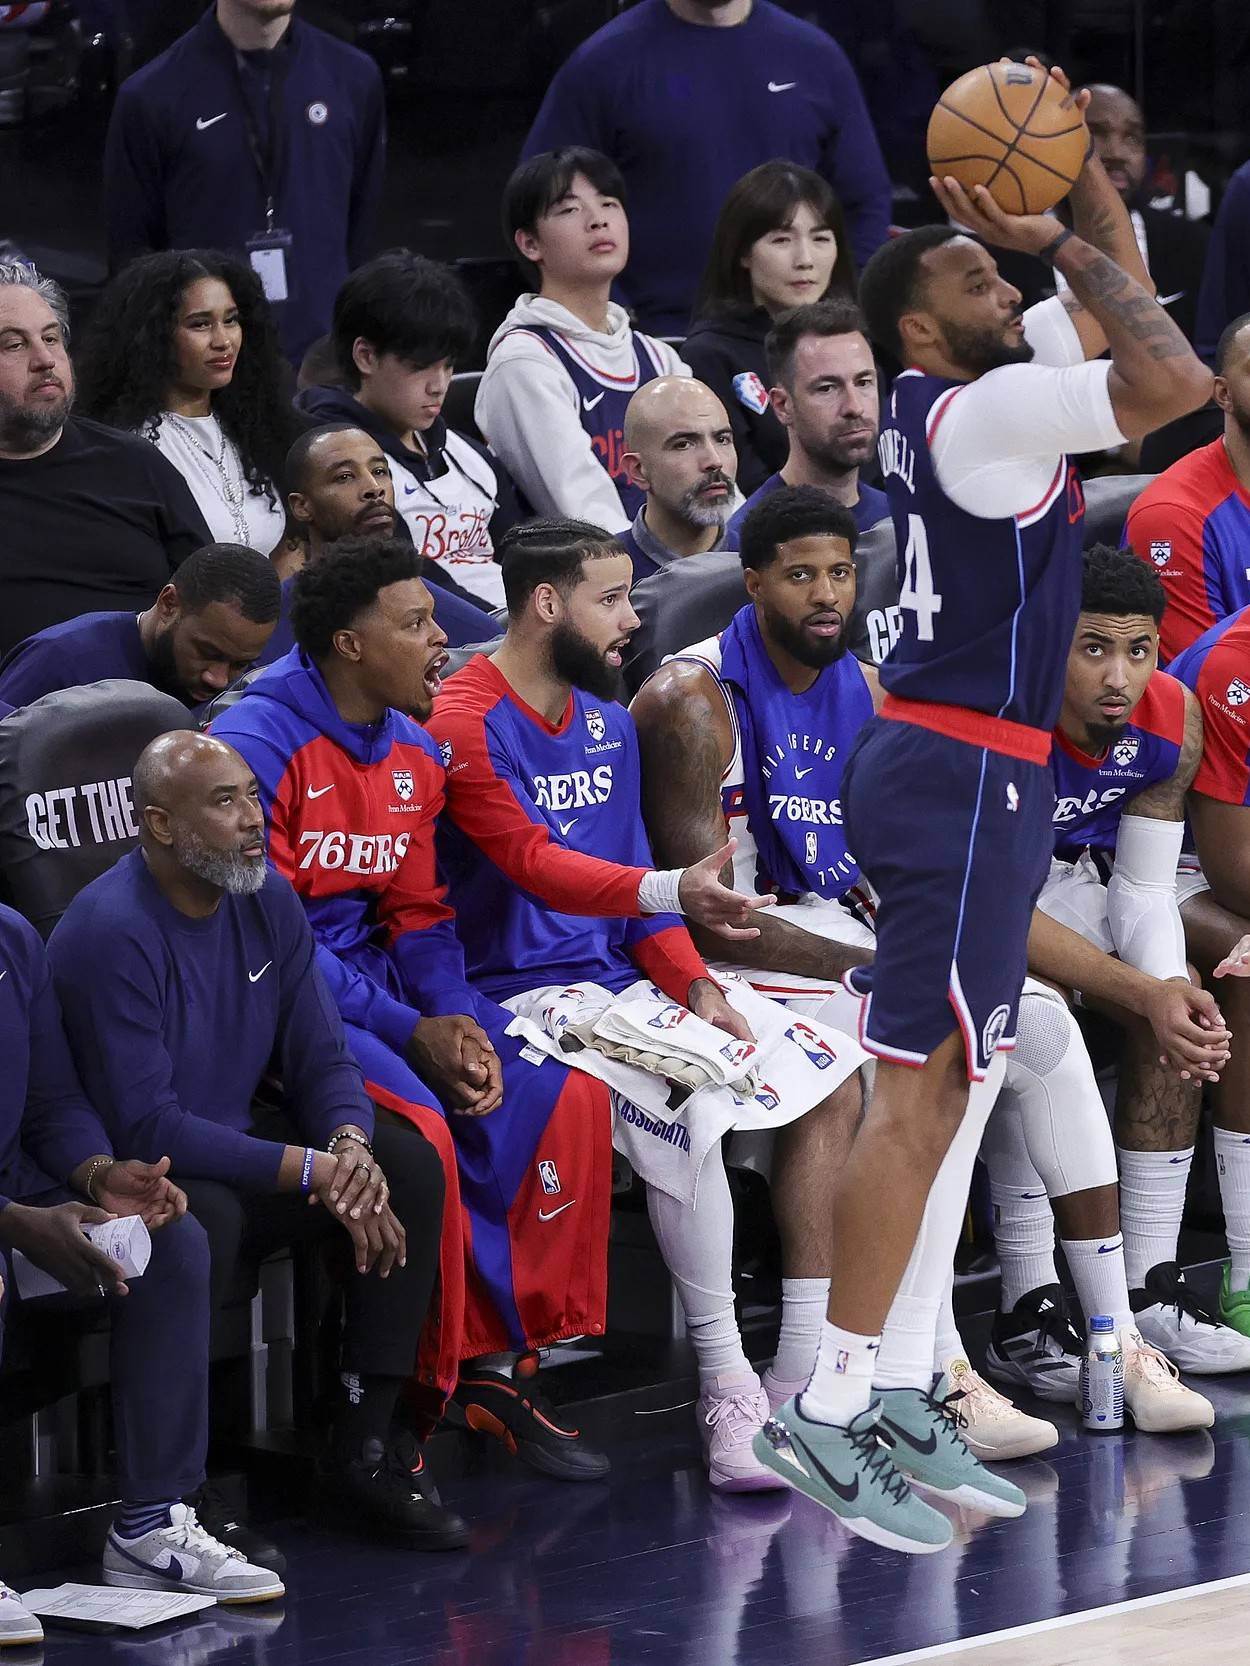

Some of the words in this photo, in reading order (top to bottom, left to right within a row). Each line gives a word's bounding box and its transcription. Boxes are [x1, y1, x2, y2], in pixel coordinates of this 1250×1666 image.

[1207, 694, 1221, 709] Penn
[1220, 704, 1247, 726] Medicine
[597, 739, 623, 753] Medicine
[1113, 768, 1145, 778] Medicine
[25, 786, 81, 851] GET
[80, 776, 140, 844] THE
[400, 804, 423, 813] Medicine
[768, 794, 844, 825] 76ERS
[299, 831, 411, 875] 76ERS
